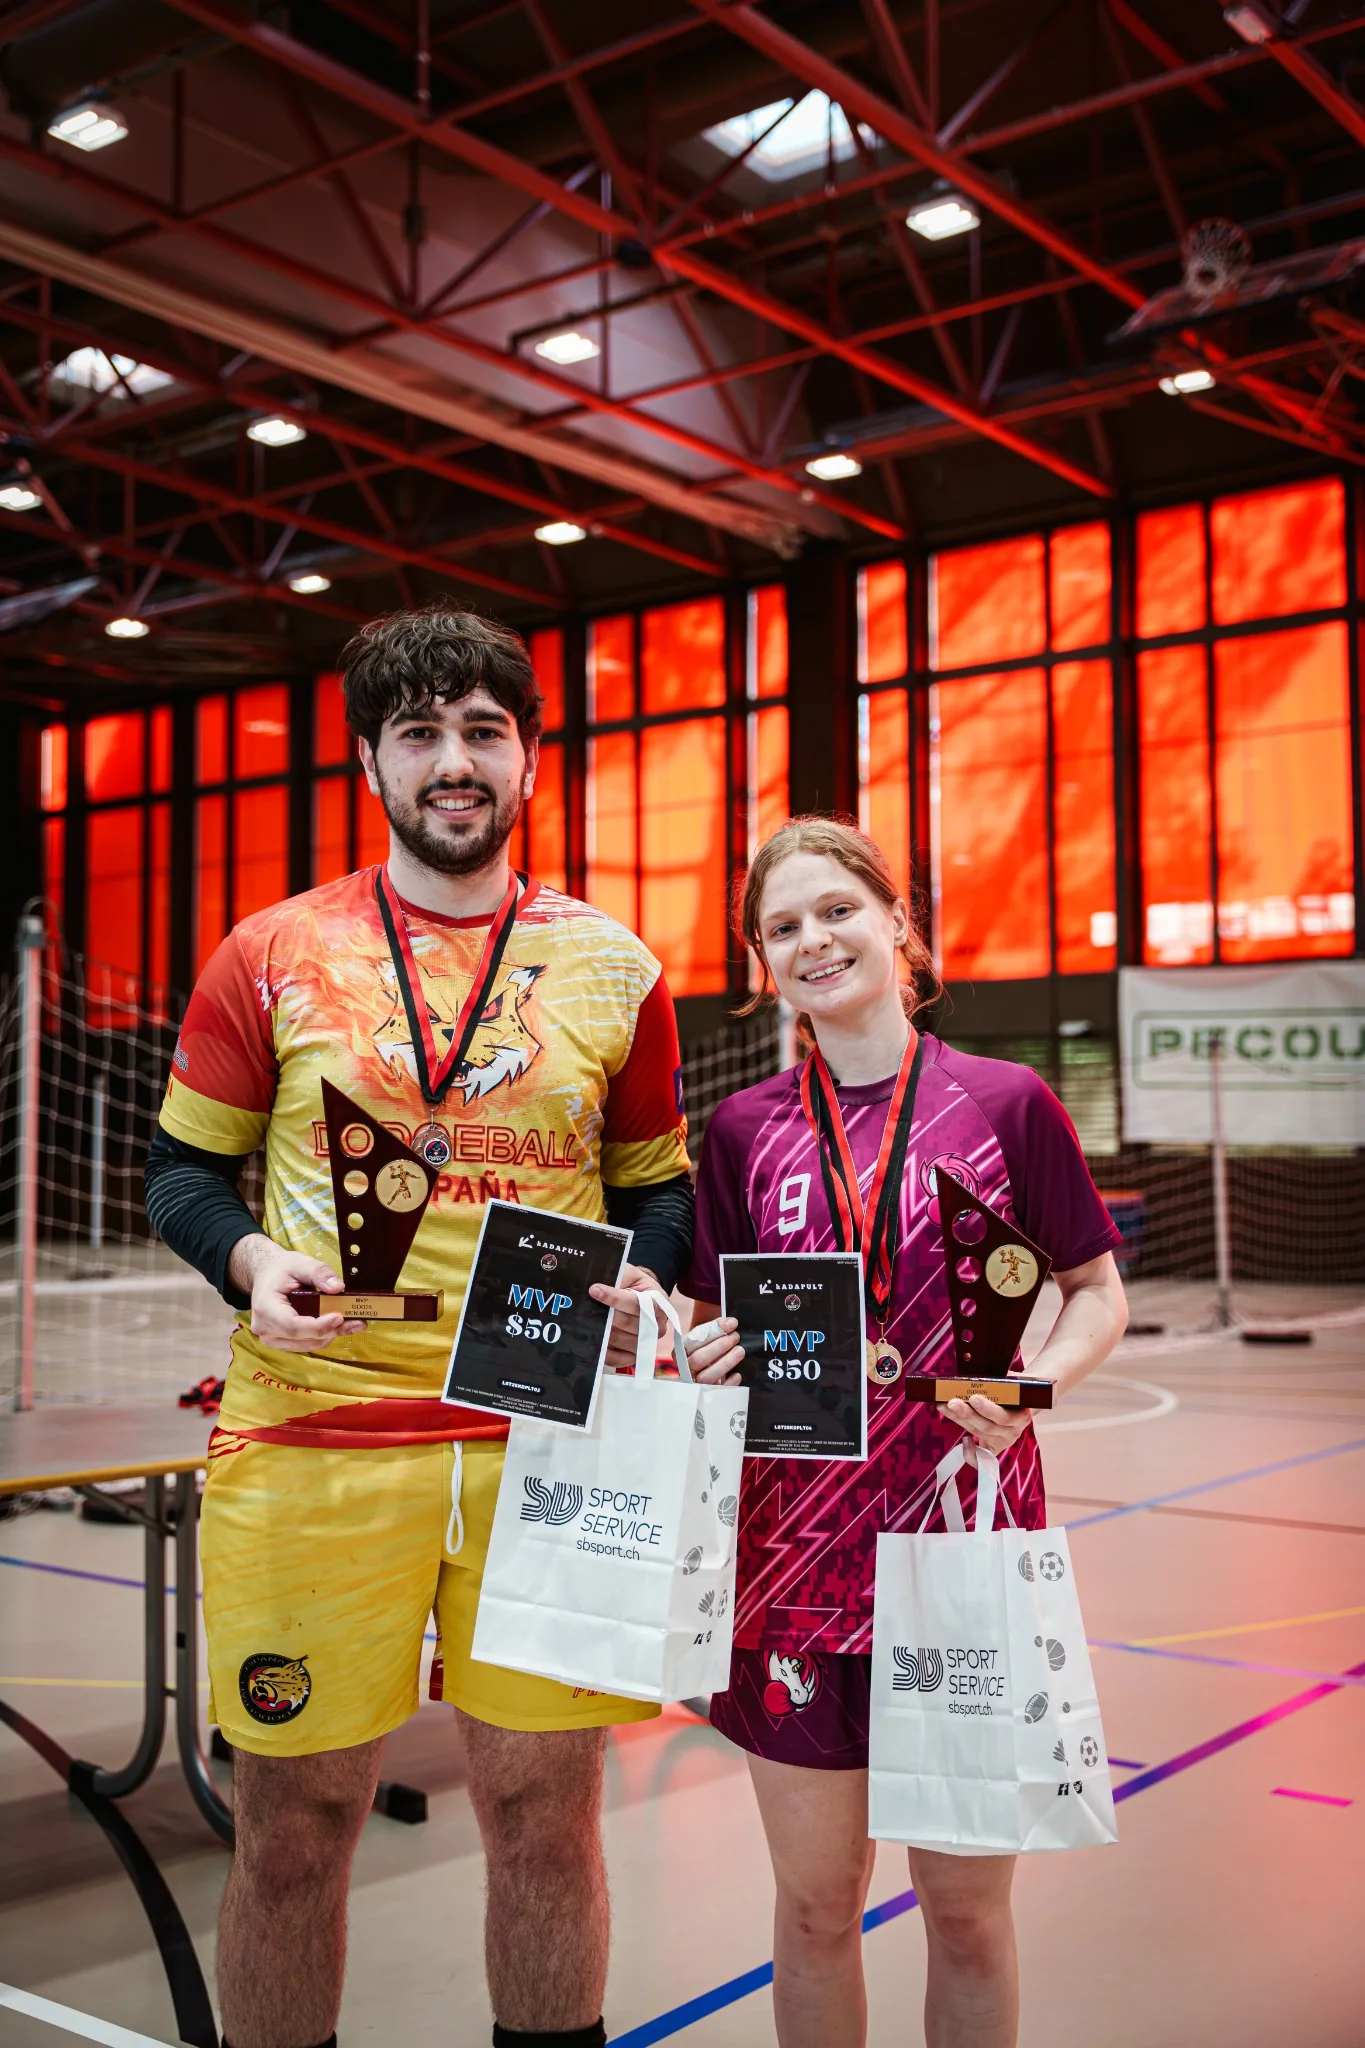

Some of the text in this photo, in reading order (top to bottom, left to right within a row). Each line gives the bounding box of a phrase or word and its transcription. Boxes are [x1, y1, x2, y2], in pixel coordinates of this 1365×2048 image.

[433, 1170, 520, 1204] PAÑA
[779, 1173, 811, 1236] 9
[507, 1284, 573, 1315] MVP
[505, 1311, 562, 1344] $50
[764, 1330, 825, 1352] MVP
[767, 1356, 821, 1382] $50
[588, 1488, 652, 1515] SPORT
[580, 1513, 663, 1545] SERVICE
[576, 1537, 640, 1560] sbsport.ch
[946, 1648, 998, 1669] SPORT
[948, 1675, 1005, 1696] SERVICE
[948, 1700, 993, 1717] sbsport.ch
